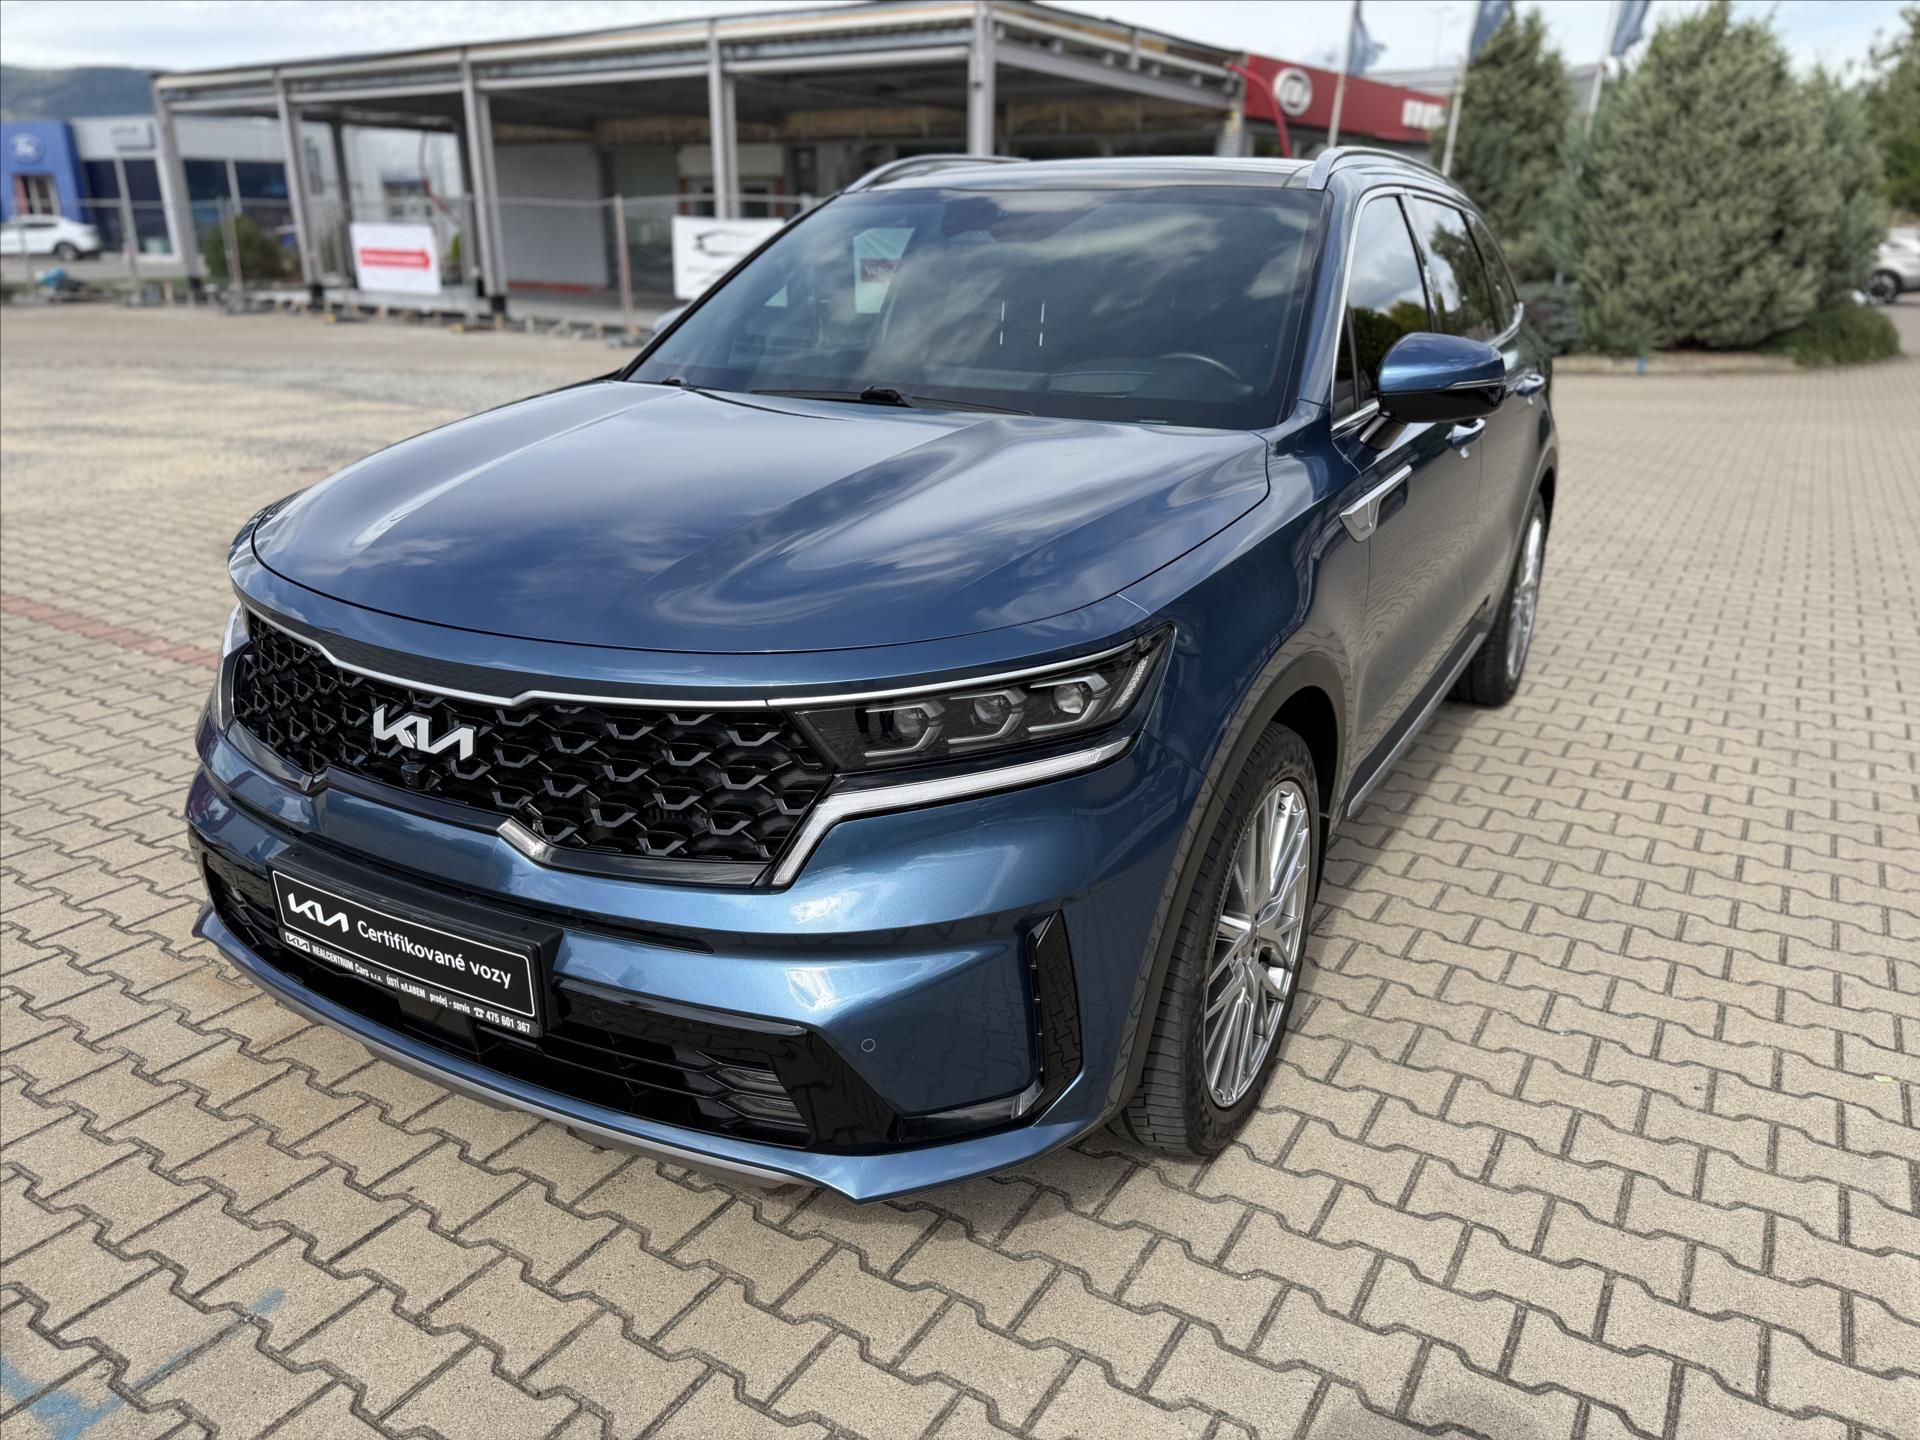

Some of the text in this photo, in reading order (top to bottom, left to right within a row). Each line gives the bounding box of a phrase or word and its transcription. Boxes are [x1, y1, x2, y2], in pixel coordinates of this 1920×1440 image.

[373, 704, 477, 761] KIA
[287, 892, 512, 989] KIA Certifikované vozy
[312, 945, 354, 970] REALCENTRUM
[355, 963, 369, 977] Cars
[386, 974, 399, 989] ÚSTÍ
[429, 993, 448, 1007] prodej
[453, 1000, 470, 1014] servis
[486, 1009, 500, 1023] 475
[501, 1015, 514, 1028] 601
[516, 1020, 530, 1033] 367
